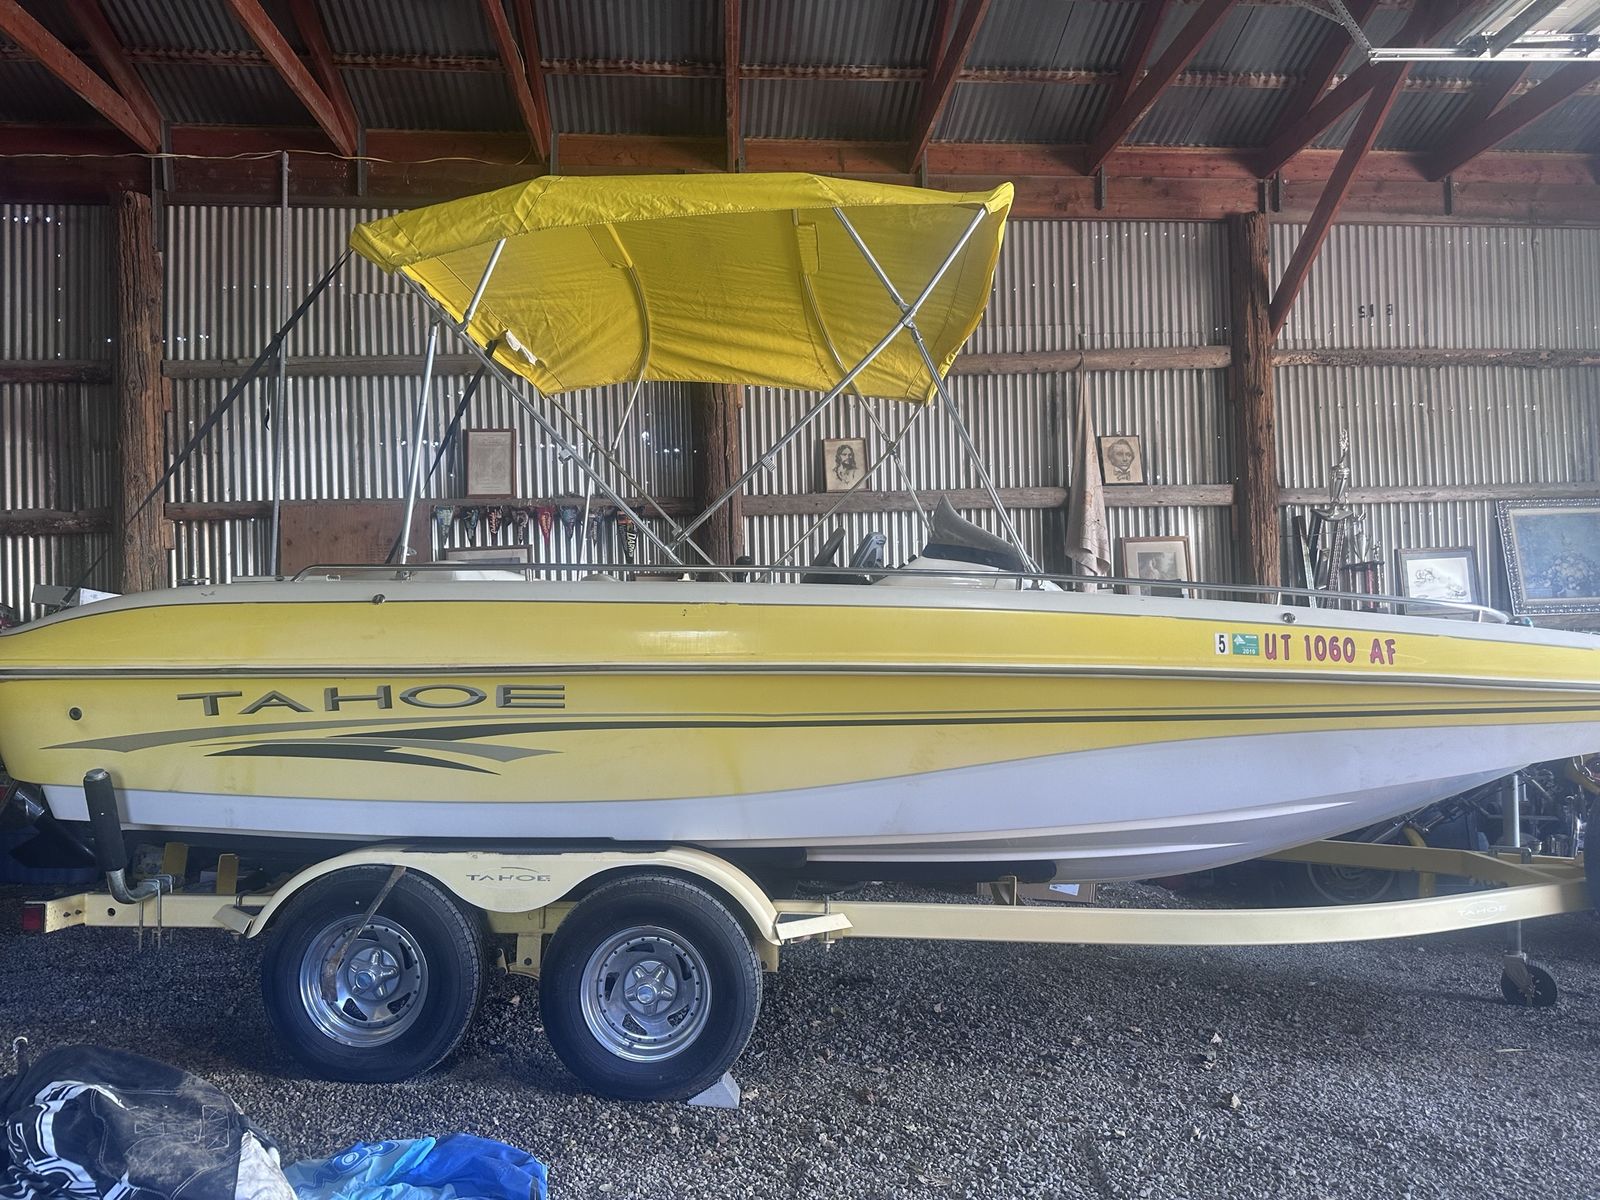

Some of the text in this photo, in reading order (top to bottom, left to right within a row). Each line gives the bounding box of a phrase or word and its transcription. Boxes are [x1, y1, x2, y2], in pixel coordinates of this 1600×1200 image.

[1218, 634, 1226, 654] 5
[1264, 632, 1292, 660] UT
[1304, 634, 1356, 664] 1060
[1369, 638, 1396, 665] AF
[177, 684, 566, 717] TAHOE
[466, 874, 551, 882] TAHOE
[1457, 904, 1507, 917] TAHOE
